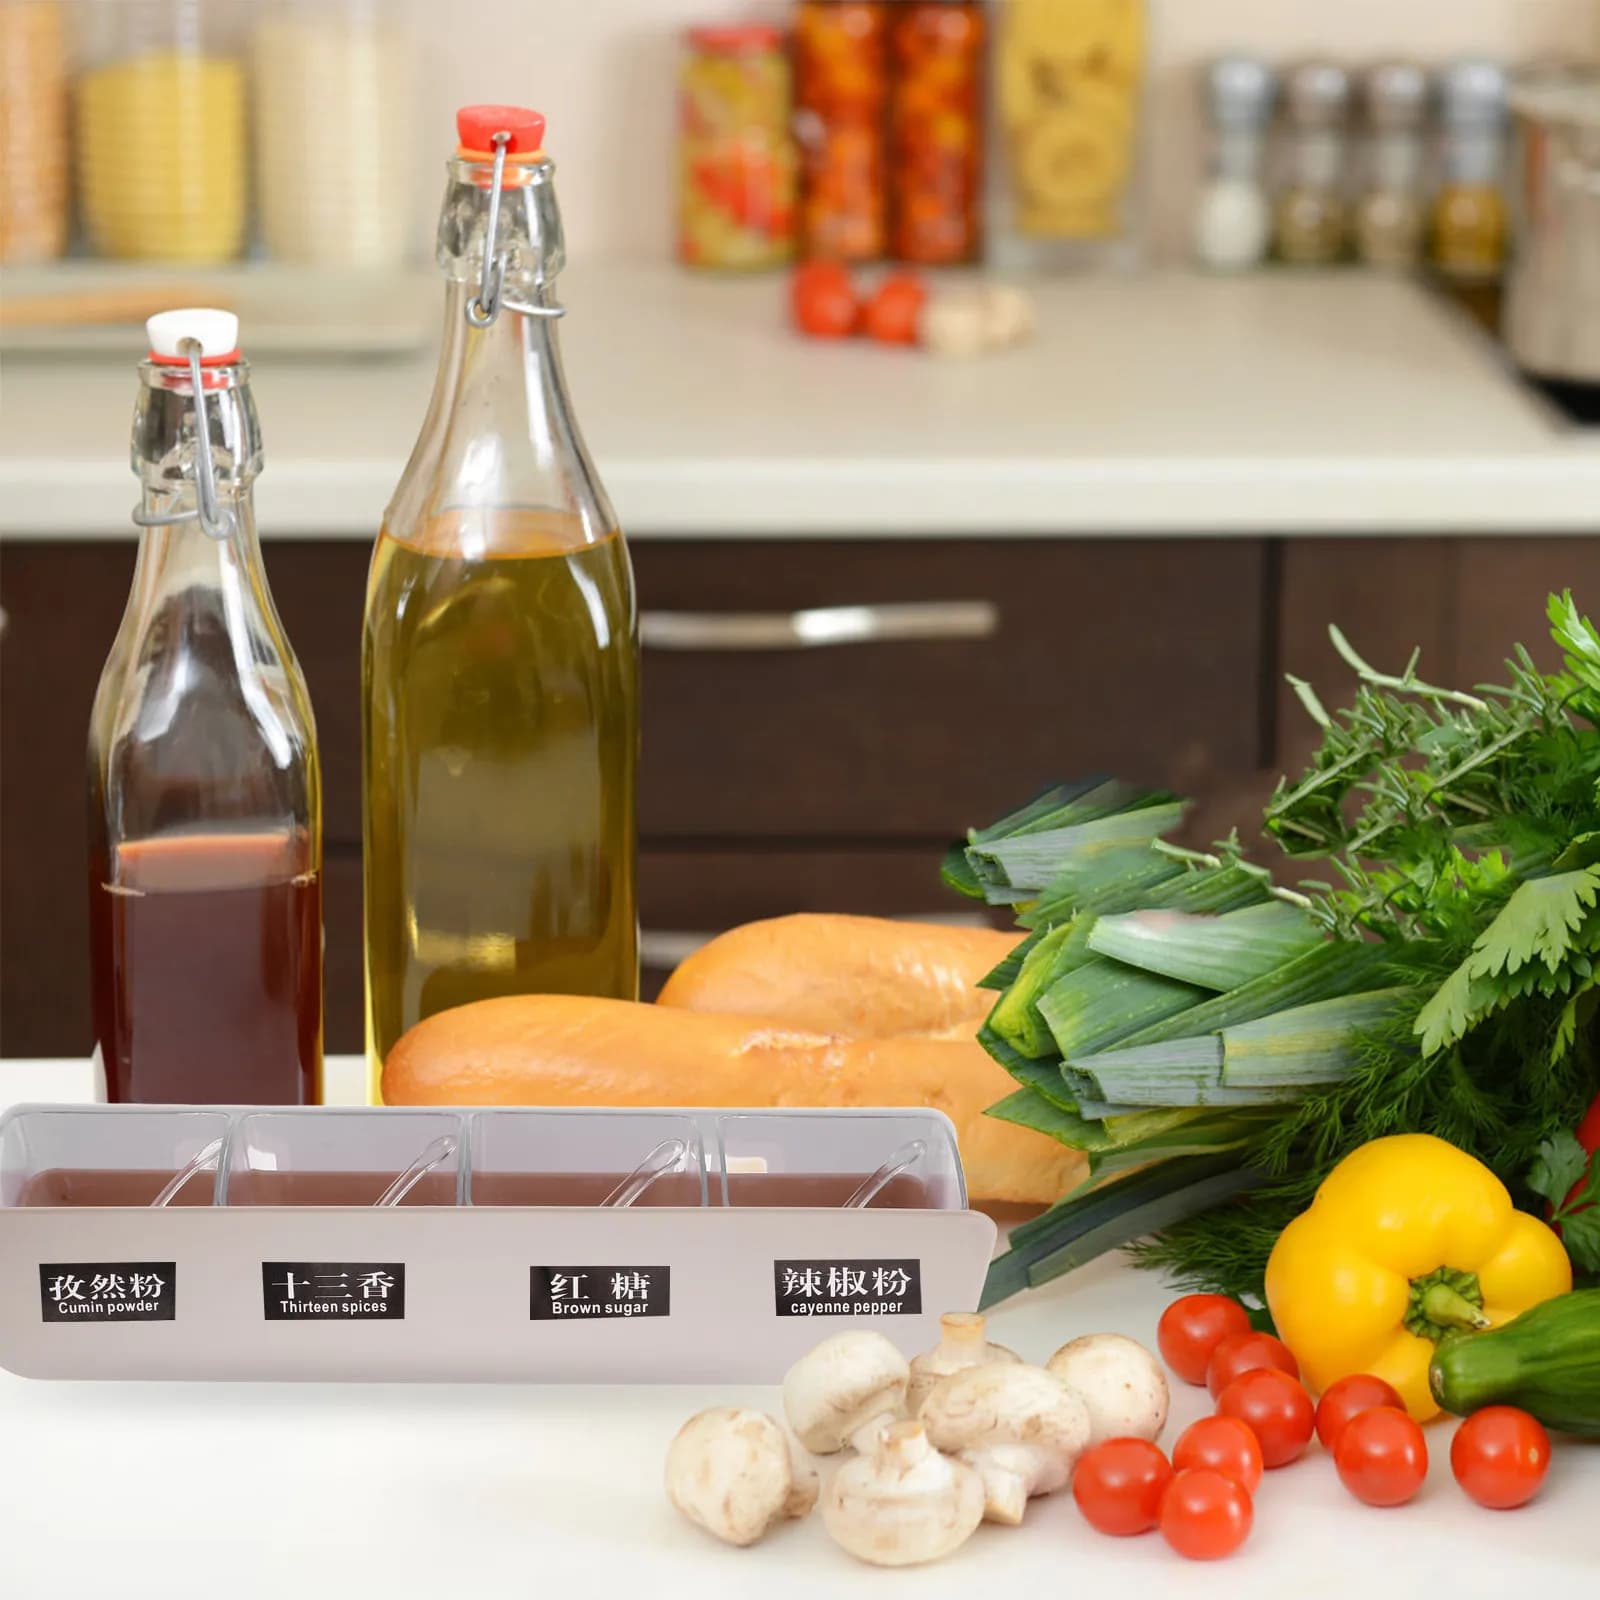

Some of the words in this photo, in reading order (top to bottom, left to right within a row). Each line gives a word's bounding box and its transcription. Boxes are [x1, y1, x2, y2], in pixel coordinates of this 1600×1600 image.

[48, 1273, 166, 1300] 孜然粉
[271, 1271, 395, 1299] 十三香
[781, 1266, 912, 1297] 辣椒粉
[58, 1302, 104, 1314] Cumin
[107, 1300, 159, 1315] powder
[280, 1300, 338, 1313] Thirteen
[342, 1300, 387, 1315] spices
[551, 1301, 600, 1314] Brown
[605, 1301, 648, 1317] sugar
[791, 1301, 850, 1315] cayenne
[853, 1300, 904, 1316] pepper
